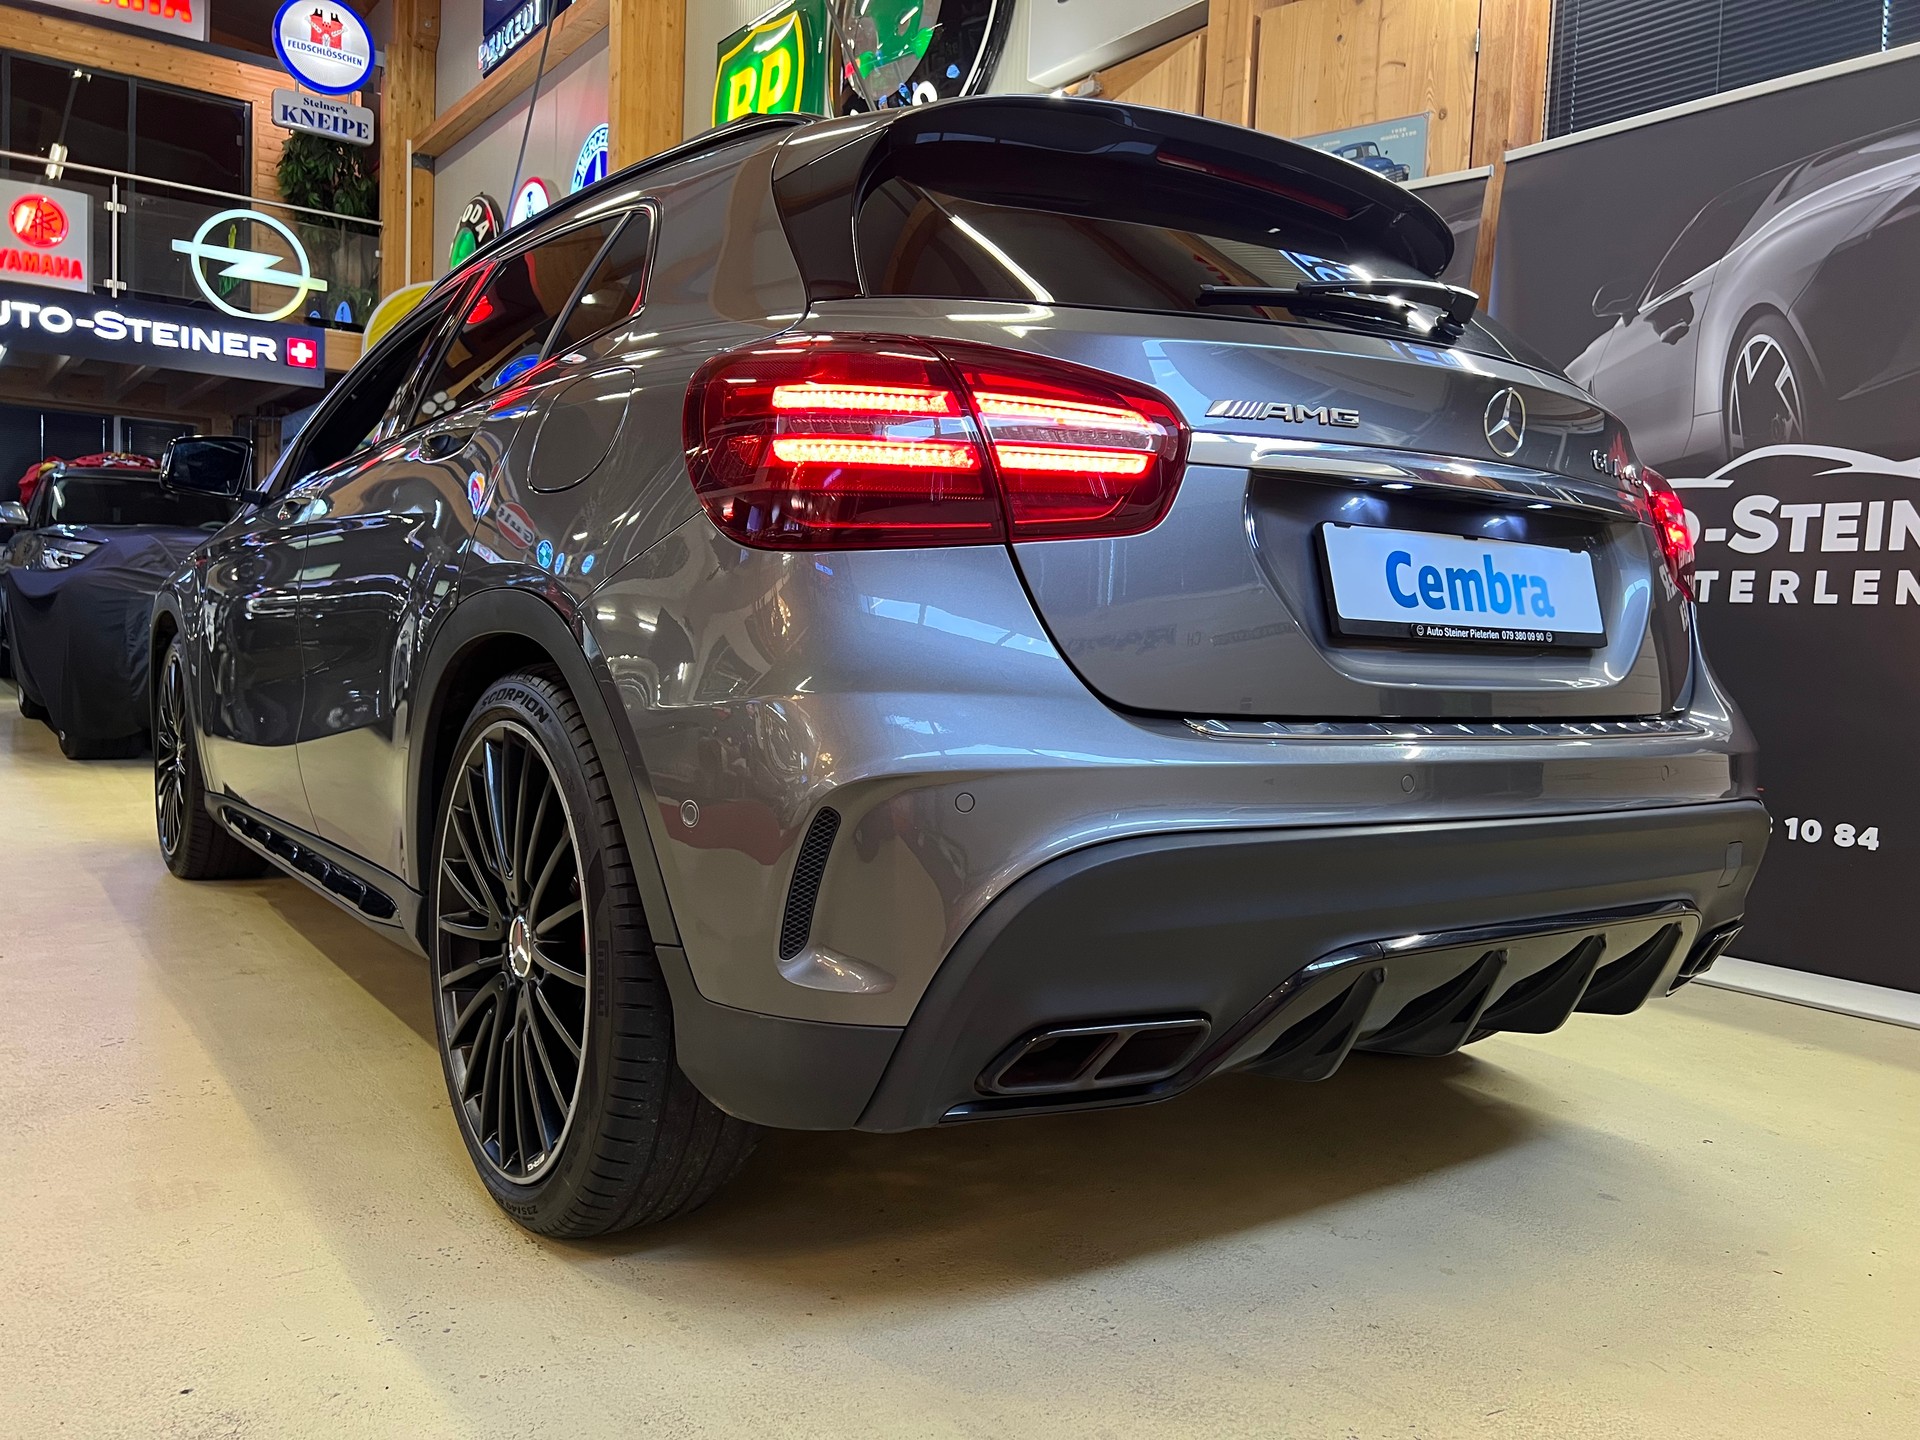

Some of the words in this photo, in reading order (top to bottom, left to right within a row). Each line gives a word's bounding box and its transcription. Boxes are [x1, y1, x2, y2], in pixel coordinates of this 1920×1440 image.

[287, 39, 362, 66] FELDSCHLÖSSCHEN
[727, 47, 791, 121] BP
[281, 104, 369, 139] KNEIPE
[303, 96, 348, 115] Steiner's
[1385, 550, 1556, 618] Cembra
[1426, 626, 1443, 637] Auto
[1444, 628, 1469, 638] Steiner
[1470, 629, 1500, 640] Pieterlen
[1501, 630, 1514, 640] 079
[1515, 631, 1527, 641] 380
[1527, 632, 1536, 641] 09
[1536, 633, 1545, 642] 90
[480, 687, 549, 724] SCORPION
[1784, 817, 1823, 843] 10
[1833, 823, 1880, 851] 84
